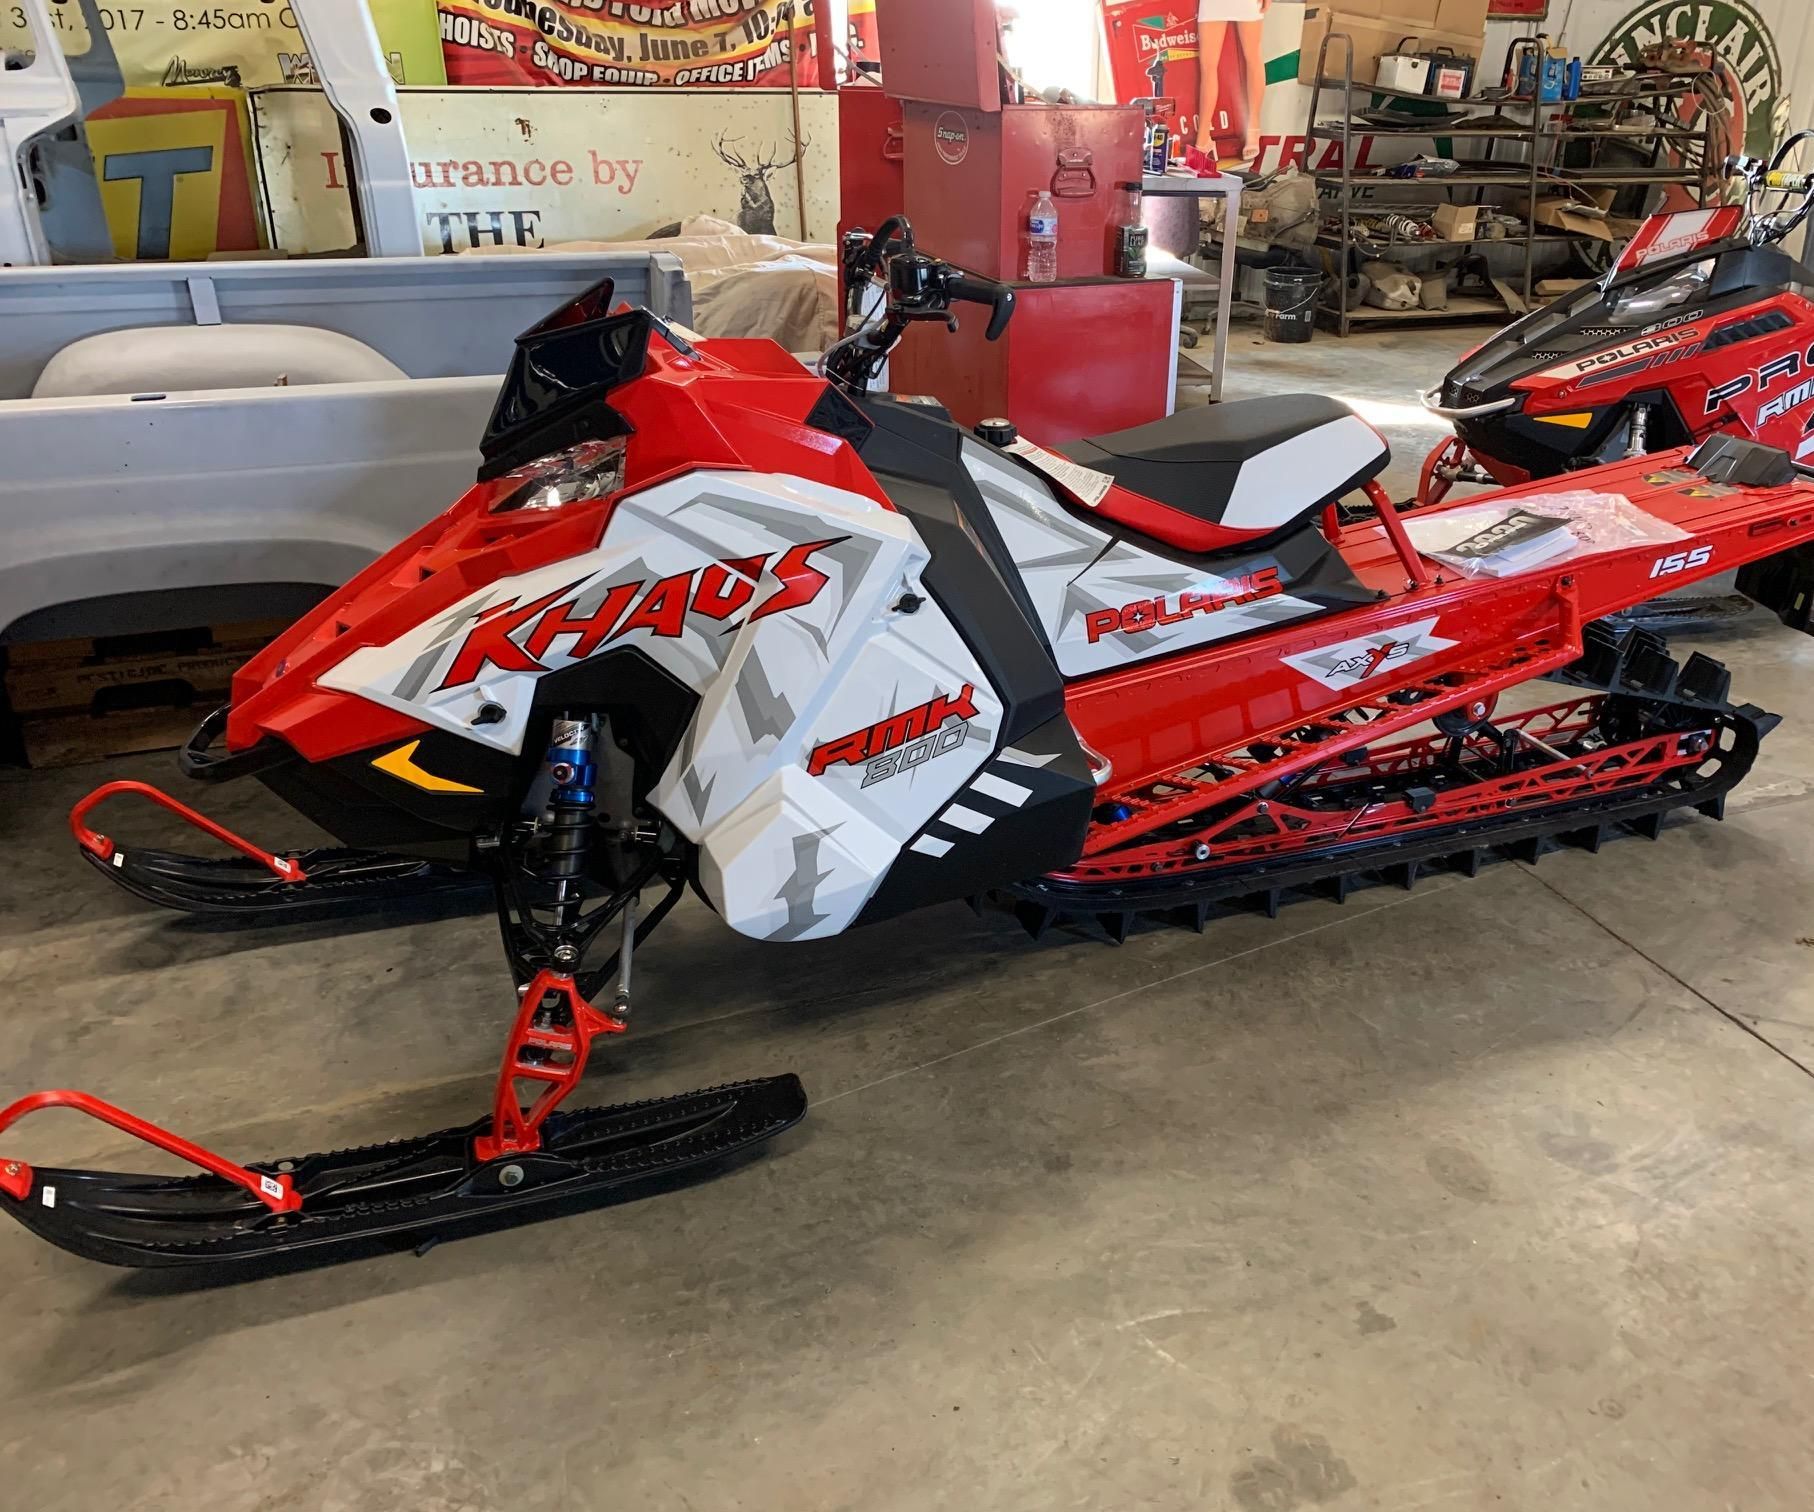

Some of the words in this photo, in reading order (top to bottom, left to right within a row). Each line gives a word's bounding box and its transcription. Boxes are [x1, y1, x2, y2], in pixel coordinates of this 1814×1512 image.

[85, 8, 144, 31] 017
[173, 9, 271, 31] 8:45am
[472, 0, 634, 63] nesday,
[639, 32, 708, 62] June
[1140, 30, 1200, 52] Budweis
[440, 12, 515, 60] HOISTS
[533, 41, 588, 80] SHOP
[675, 61, 744, 85] OFFICE
[1609, 4, 1775, 116] INCLAIR
[1180, 110, 1228, 135] COD
[320, 151, 575, 189] Iurance
[588, 149, 644, 195] by
[1318, 186, 1376, 200] ATVE
[104, 145, 214, 260] T
[426, 209, 546, 255] THE
[1635, 230, 1710, 261] POLARIS
[1641, 309, 1704, 337] 800
[1575, 327, 1700, 372] POLARIS
[1704, 340, 1814, 415] PR
[1755, 376, 1814, 432] RM
[1648, 544, 1714, 579] 155
[430, 535, 853, 693] KHAOS
[1085, 565, 1285, 645] POLARIS
[1325, 641, 1411, 680] AXYS
[806, 683, 981, 777] RMK
[860, 720, 969, 790] 800
